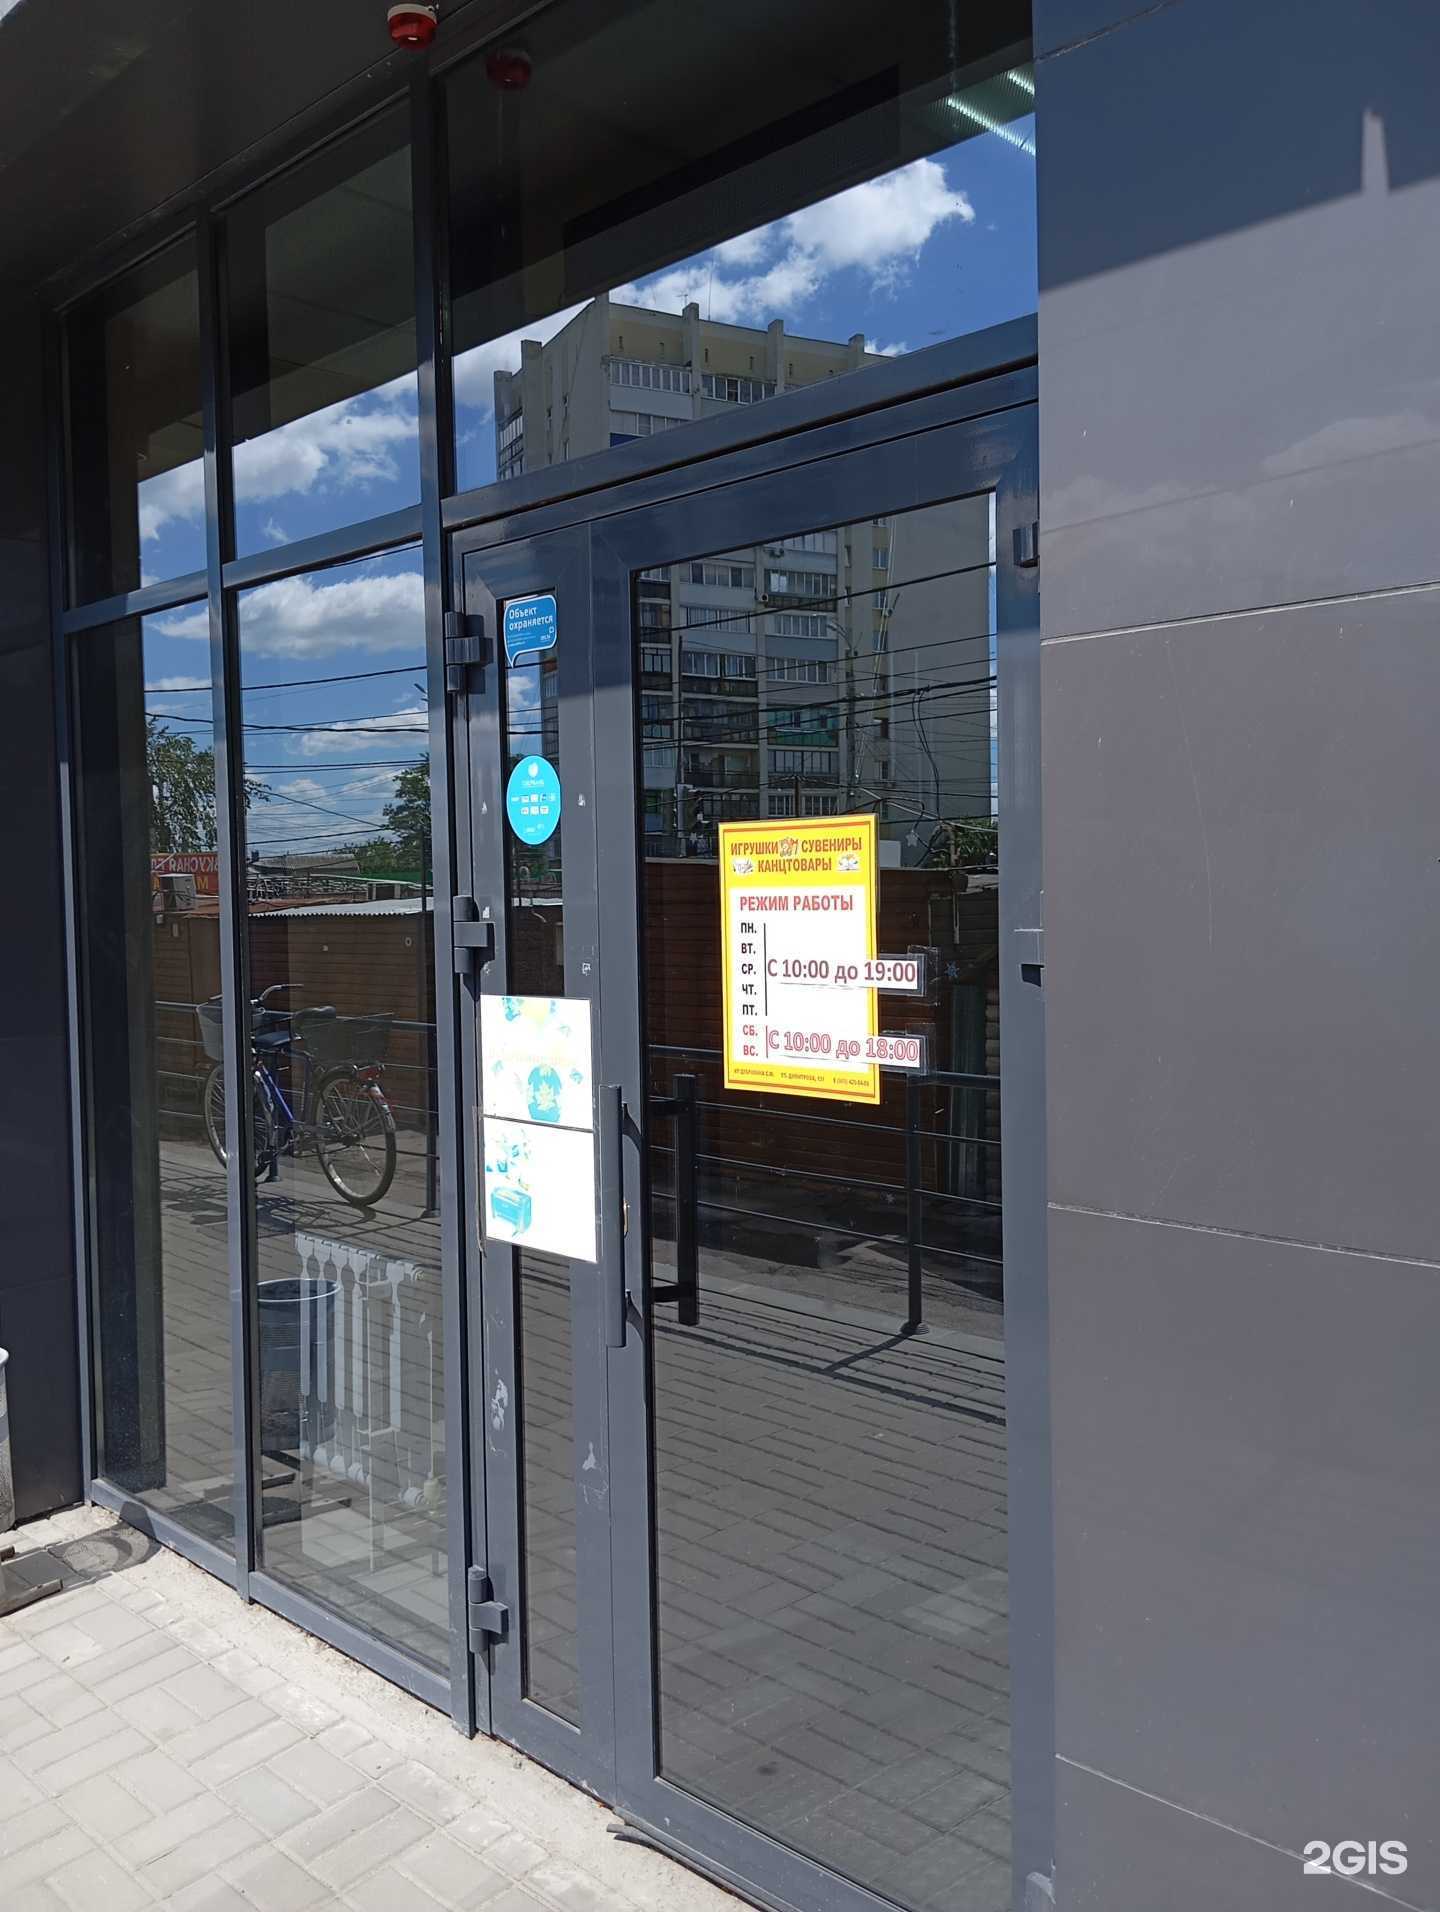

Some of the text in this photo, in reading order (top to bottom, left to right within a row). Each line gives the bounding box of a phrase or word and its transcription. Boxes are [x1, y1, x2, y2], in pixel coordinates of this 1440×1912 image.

[509, 607, 537, 620] Объект
[509, 615, 553, 632] охраняется
[730, 837, 862, 856] ИГРУШКИ СУВЕНИРЫ
[757, 858, 832, 875] КАНЦТОВАРЫ
[740, 894, 853, 911] РЕЖИМ РАБОТЫ
[740, 922, 757, 934] ПН.
[741, 943, 756, 954] ВТ.
[741, 963, 757, 975] СР.
[767, 959, 916, 984] С 10:00 до 19:00
[742, 984, 757, 995] ЧТ.
[742, 1004, 758, 1016] ПТ.
[742, 1025, 758, 1036] СБ.
[743, 1045, 759, 1057] ВС.
[768, 1030, 919, 1062] С 10:00 до 18:00
